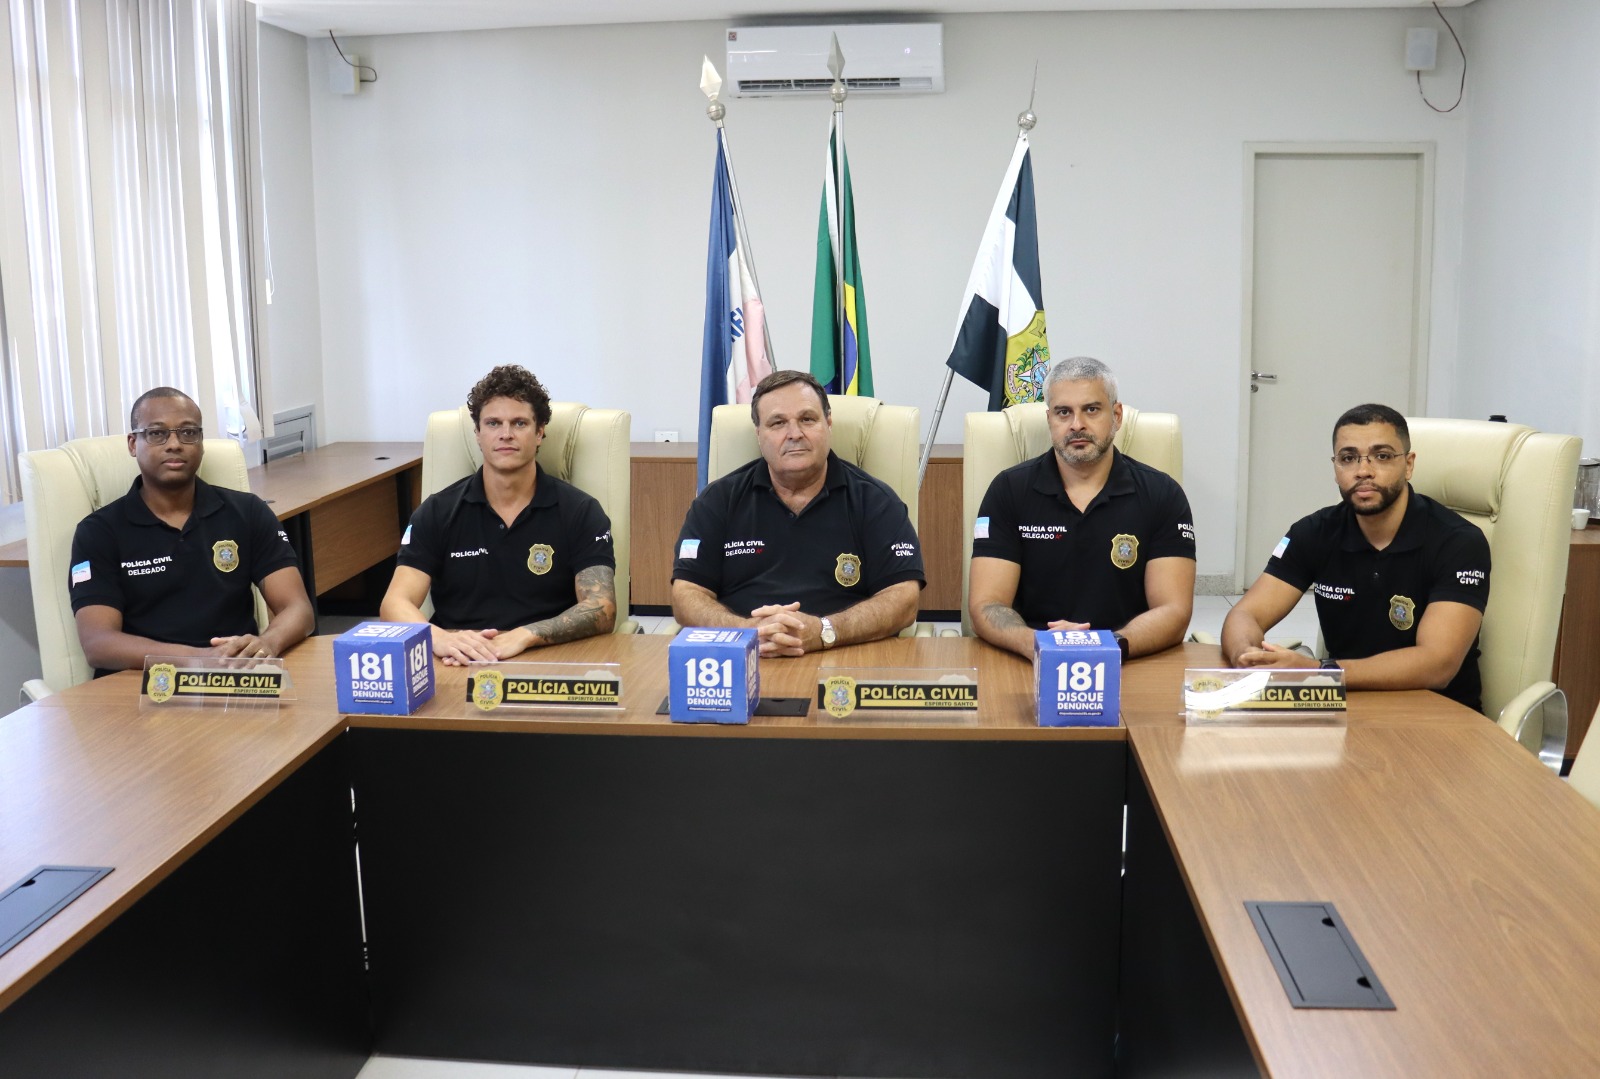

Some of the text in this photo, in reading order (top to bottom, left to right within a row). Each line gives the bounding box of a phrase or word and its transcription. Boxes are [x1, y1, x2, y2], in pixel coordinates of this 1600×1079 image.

[1018, 524, 1046, 532] POLÍCIA
[450, 550, 479, 558] POLÍCIA
[121, 556, 172, 568] POLÍCIA CIVIL
[128, 566, 166, 576] DELEGADO
[410, 639, 428, 676] 181
[348, 652, 393, 680] 181
[684, 658, 732, 688] 181
[1056, 661, 1105, 691] 181
[180, 673, 278, 688] POLÍCIA CIVIL
[352, 681, 394, 691] DISQUE
[508, 680, 615, 695] POLÍCIA CIVIL
[352, 690, 394, 698] DENÚNCIA
[686, 688, 732, 698] DISQUE
[860, 685, 973, 699] POLÍCIA CIVIL
[1058, 692, 1104, 702] DISQUE
[1299, 689, 1342, 700] CIVIL
[687, 698, 732, 706] DENÚNCIA
[1058, 702, 1104, 710] DENÚNCIA
